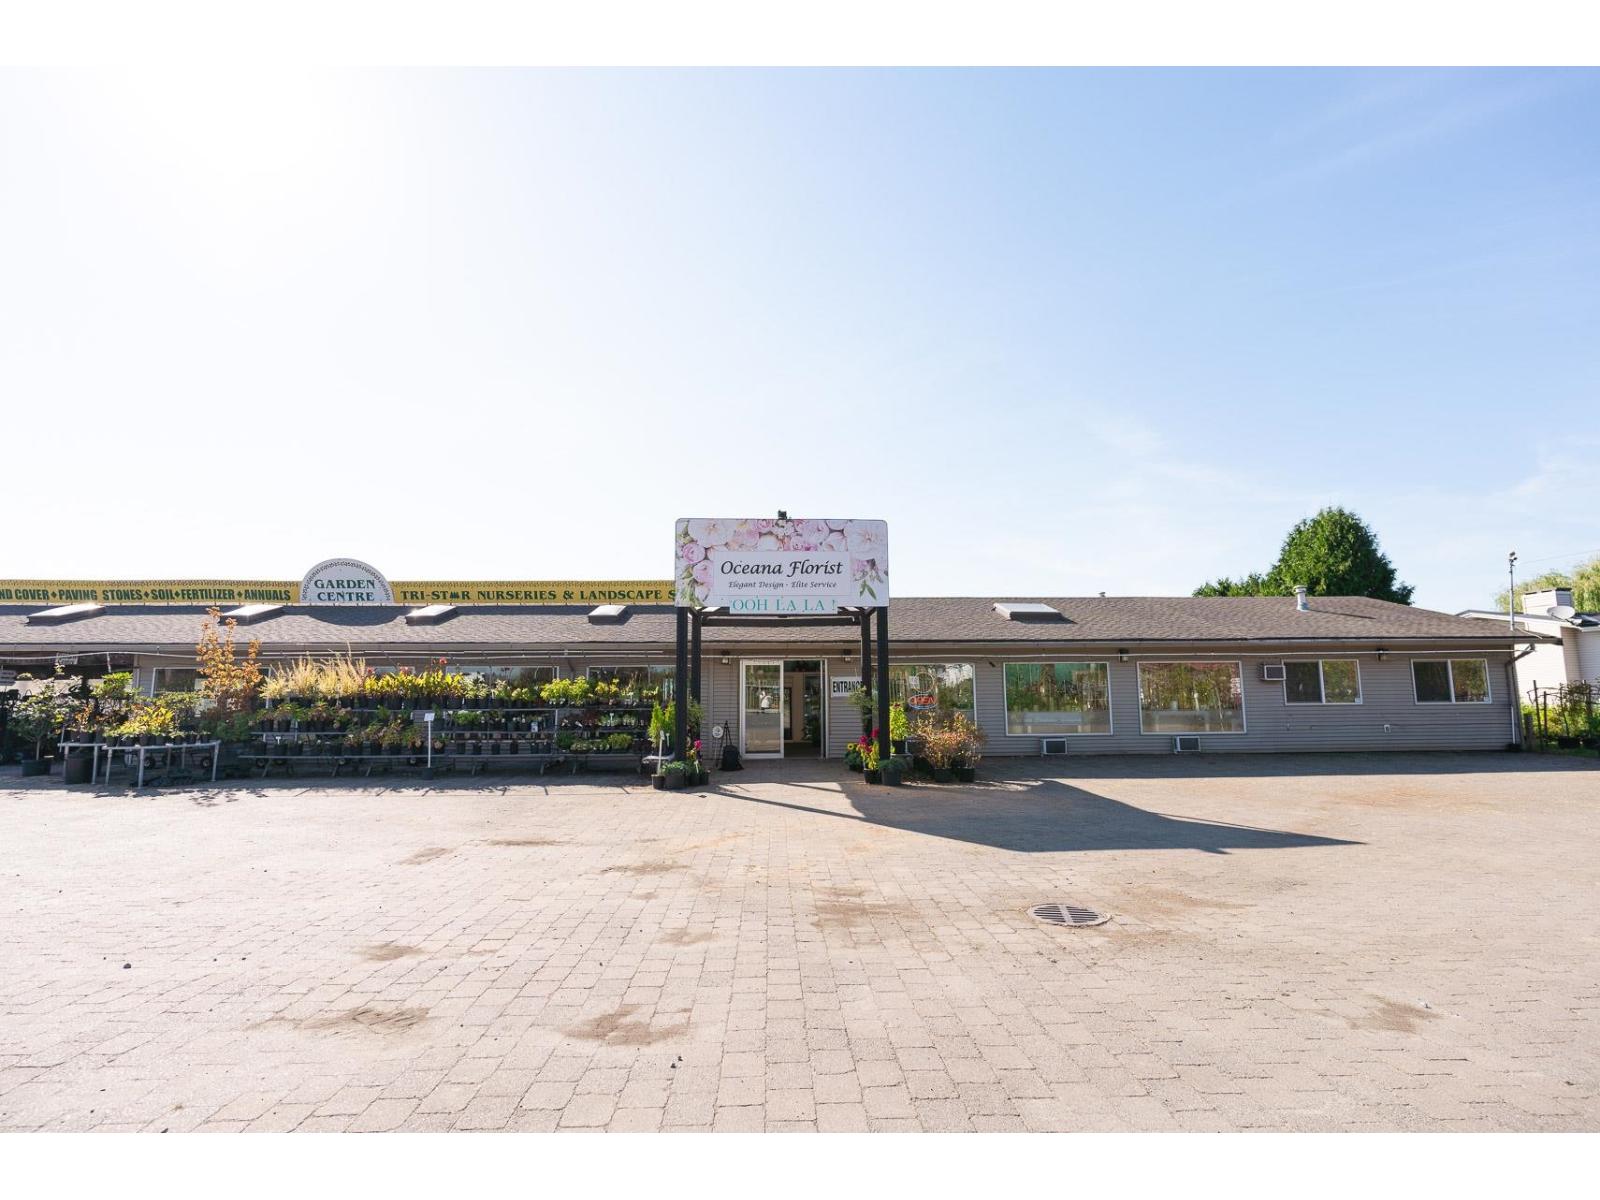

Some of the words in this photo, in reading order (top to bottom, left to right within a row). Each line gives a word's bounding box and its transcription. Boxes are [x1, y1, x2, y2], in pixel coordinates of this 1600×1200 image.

[720, 560, 783, 575] Oceana
[786, 559, 843, 577] Florist
[314, 579, 375, 589] GARDEN
[728, 581, 756, 589] Elegant
[758, 581, 784, 589] Design
[15, 589, 49, 600] COVER
[58, 589, 98, 600] PAVING
[102, 589, 143, 600] STONES
[150, 589, 175, 600] SOIL
[181, 588, 235, 600] FERTILIZER
[244, 589, 291, 601] ANNUALS
[317, 591, 375, 602] CENTRE
[477, 590, 557, 600] NURSERIES
[562, 590, 574, 600] &
[580, 590, 663, 600] LANDSCAPE
[732, 599, 768, 611] OOH
[776, 599, 797, 611] LA
[804, 599, 825, 611] LA
